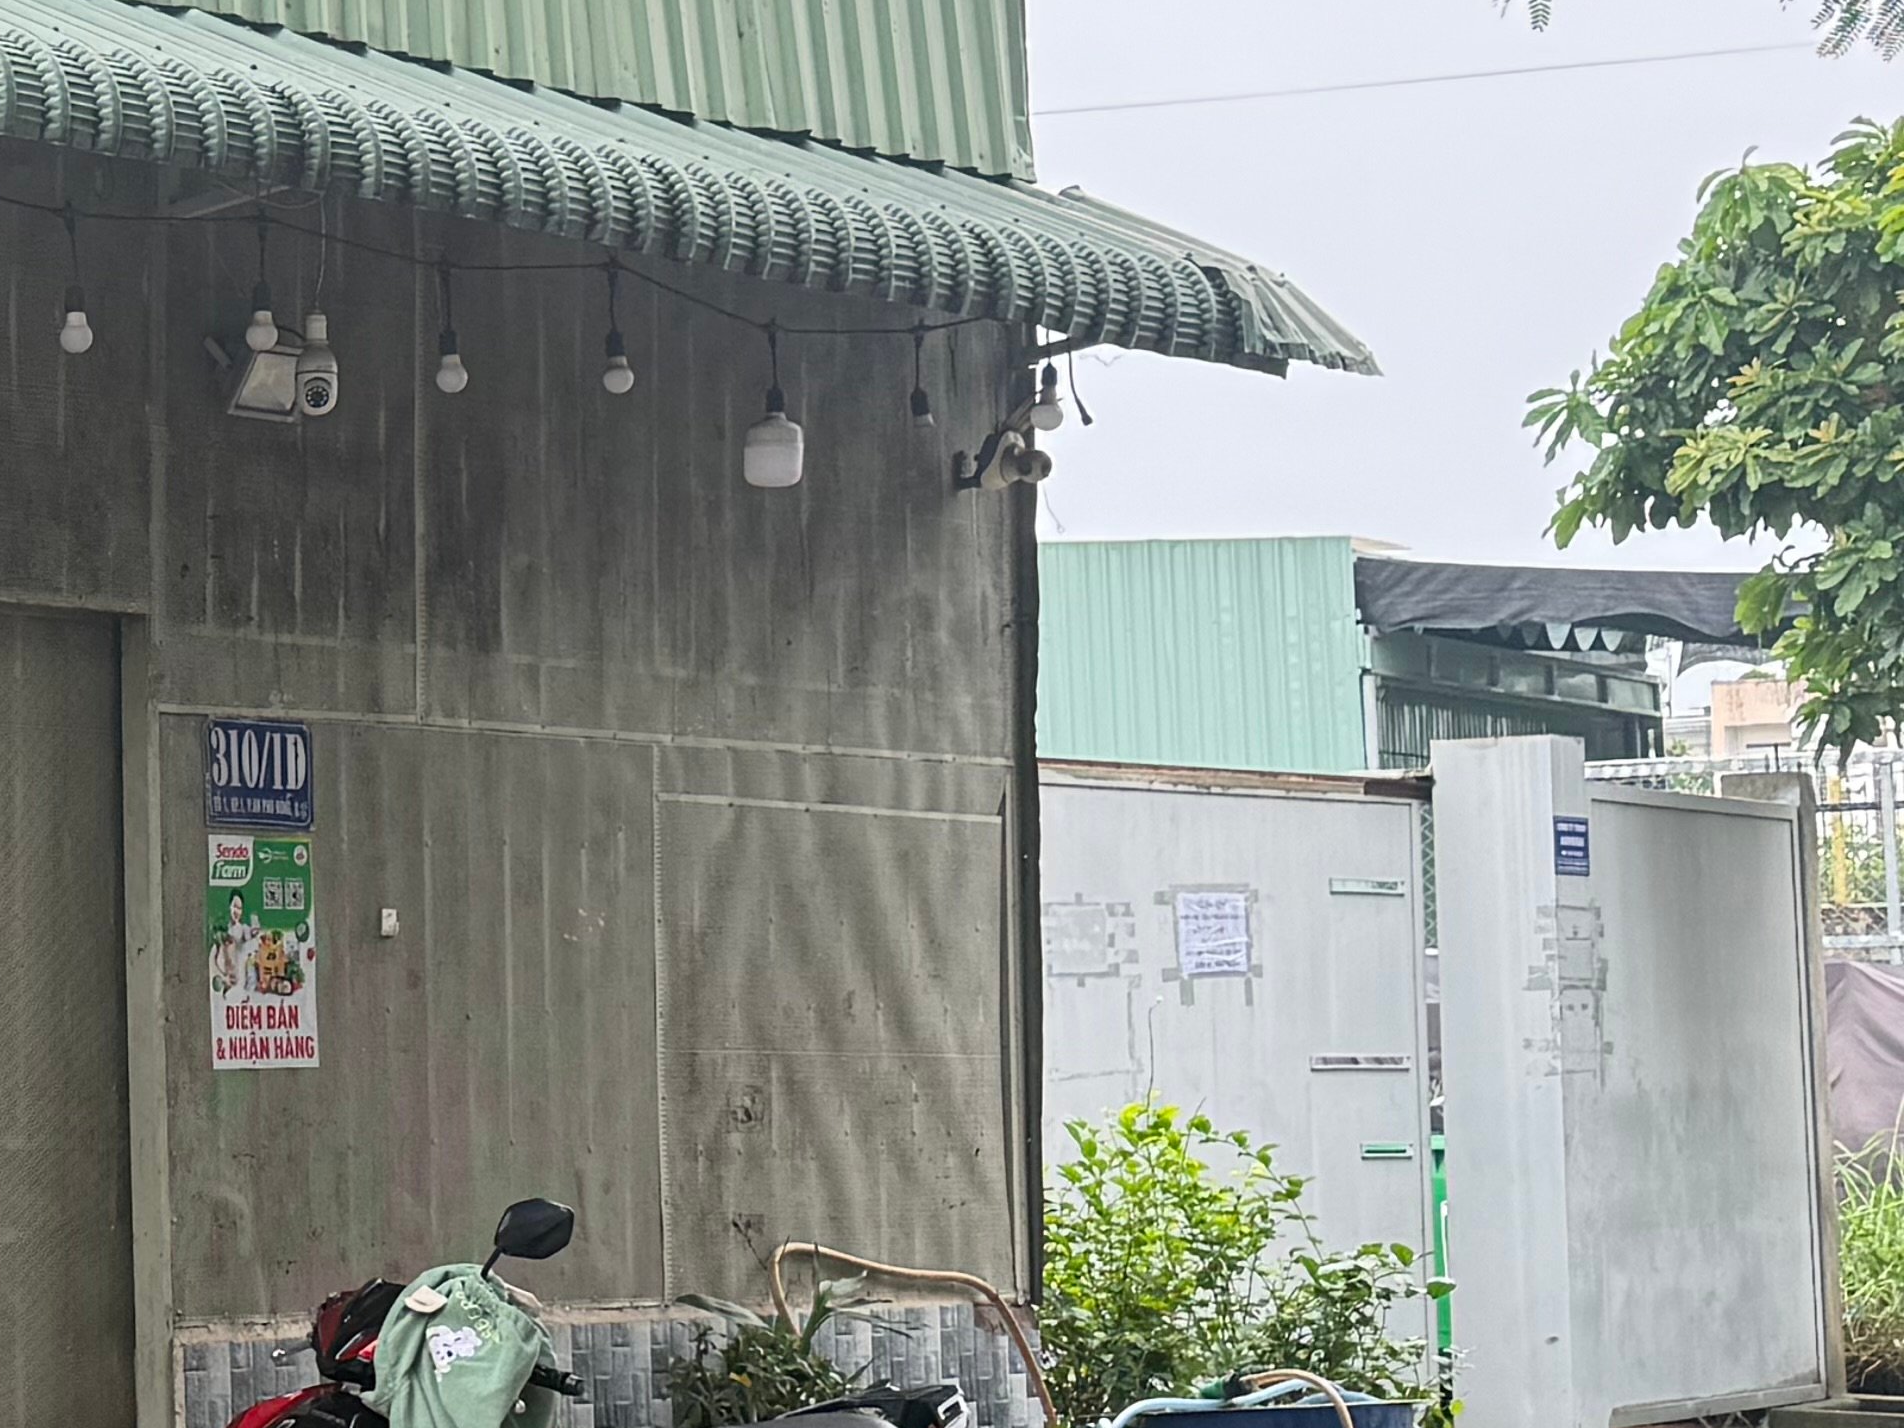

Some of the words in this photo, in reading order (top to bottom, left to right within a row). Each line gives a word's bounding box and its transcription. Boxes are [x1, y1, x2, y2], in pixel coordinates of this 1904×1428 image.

[210, 727, 307, 790] 310/1D
[216, 843, 249, 860] Sendo
[225, 995, 263, 1030] ĐIỂM
[266, 998, 300, 1030] BÁN
[216, 1037, 227, 1061] &
[229, 1031, 271, 1065] NHẬN
[274, 1030, 316, 1060] HÀNG
